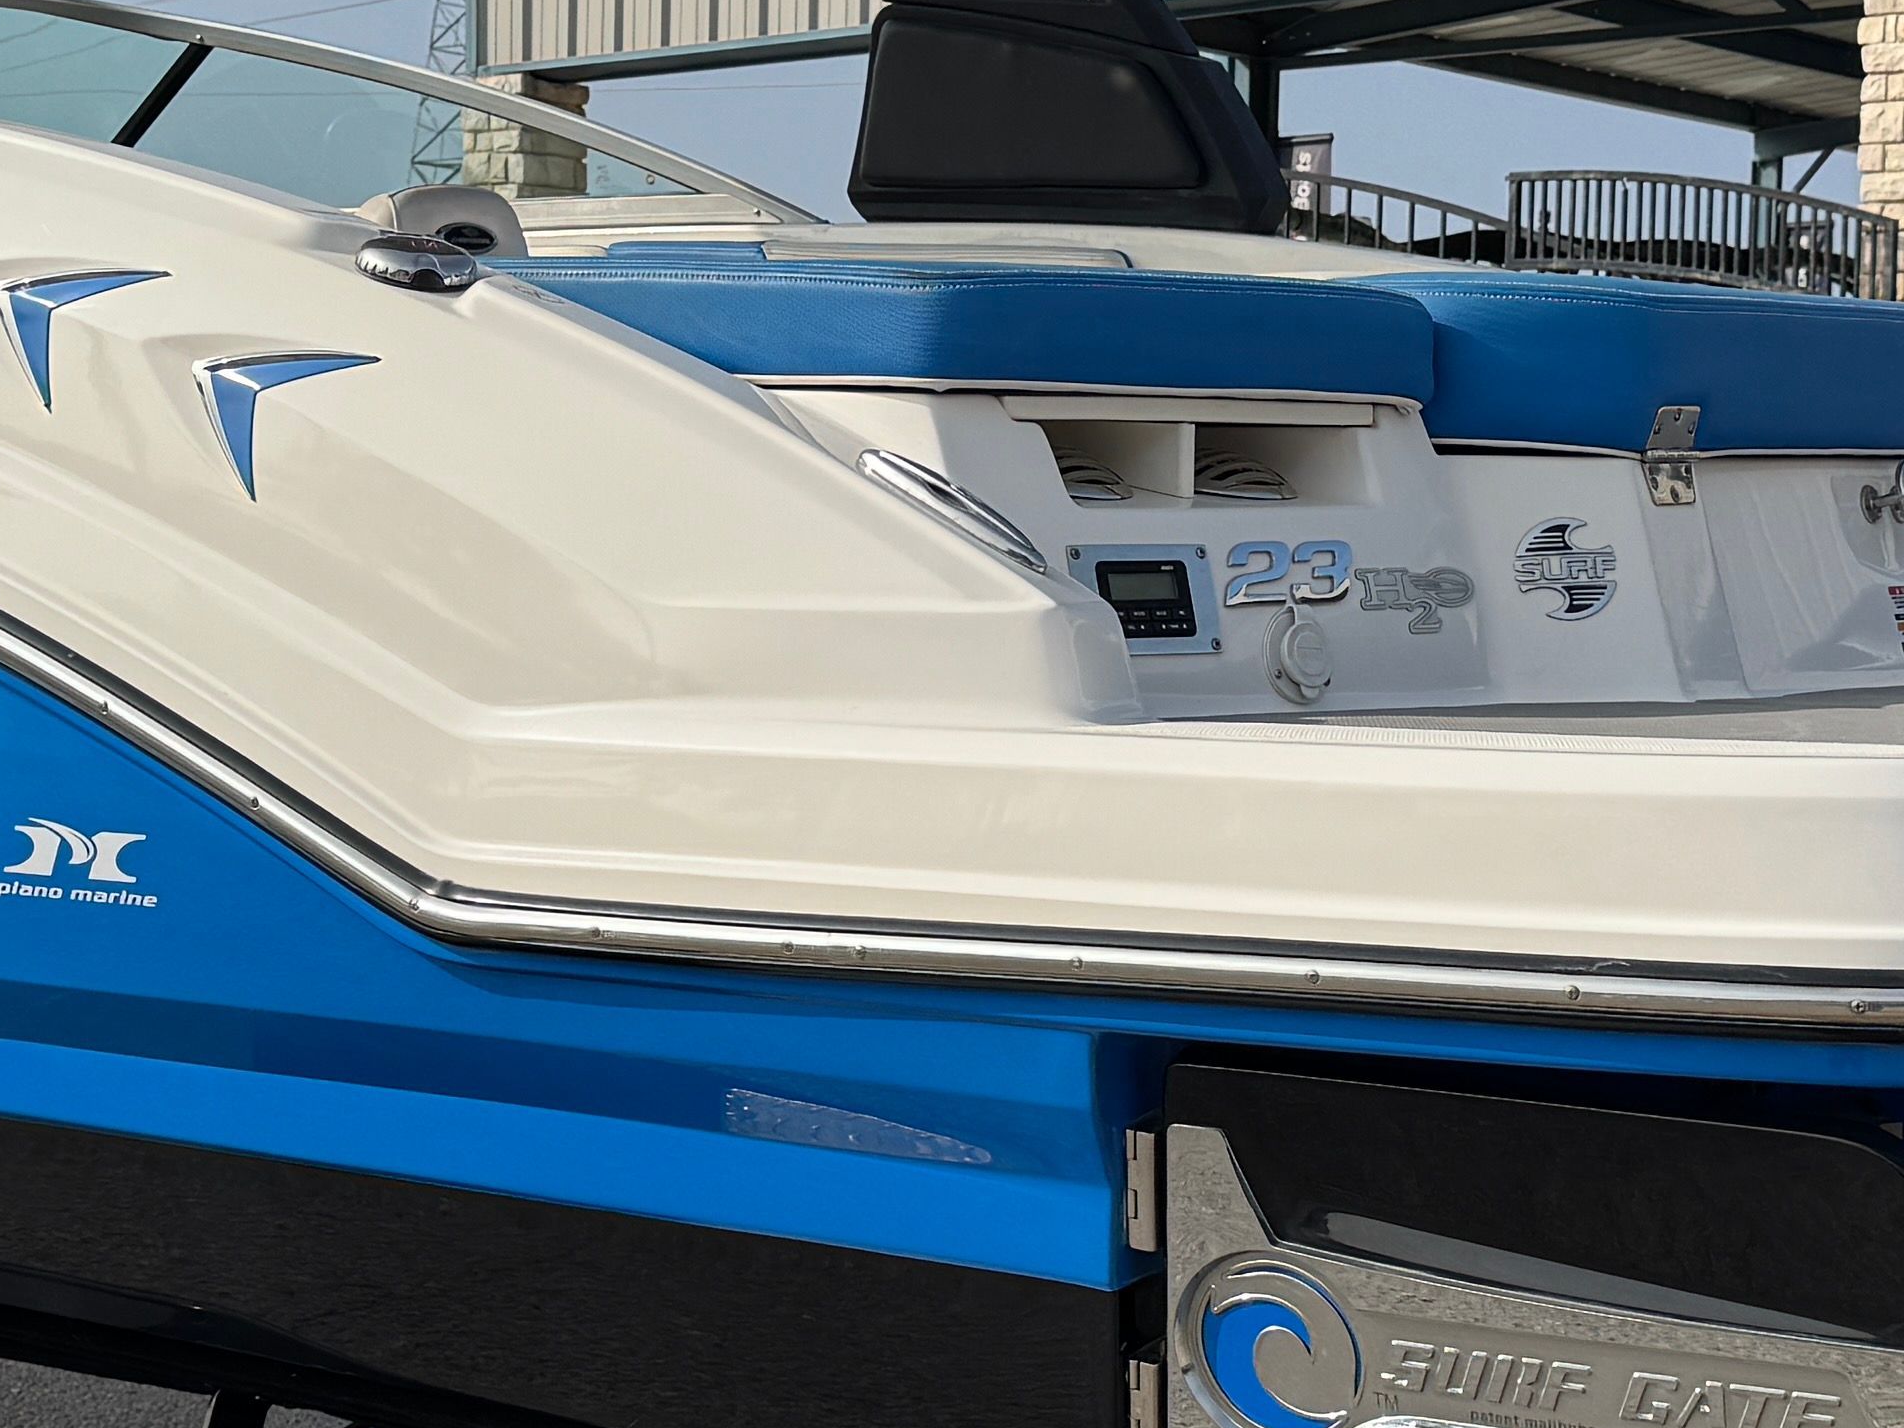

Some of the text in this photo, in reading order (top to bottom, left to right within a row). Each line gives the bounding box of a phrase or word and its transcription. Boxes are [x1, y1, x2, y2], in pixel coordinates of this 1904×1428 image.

[1291, 150, 1312, 211] Bots
[1224, 539, 1353, 608] 23
[1513, 554, 1617, 583] SURF
[69, 888, 159, 909] marine
[1380, 1338, 1593, 1412] SURF
